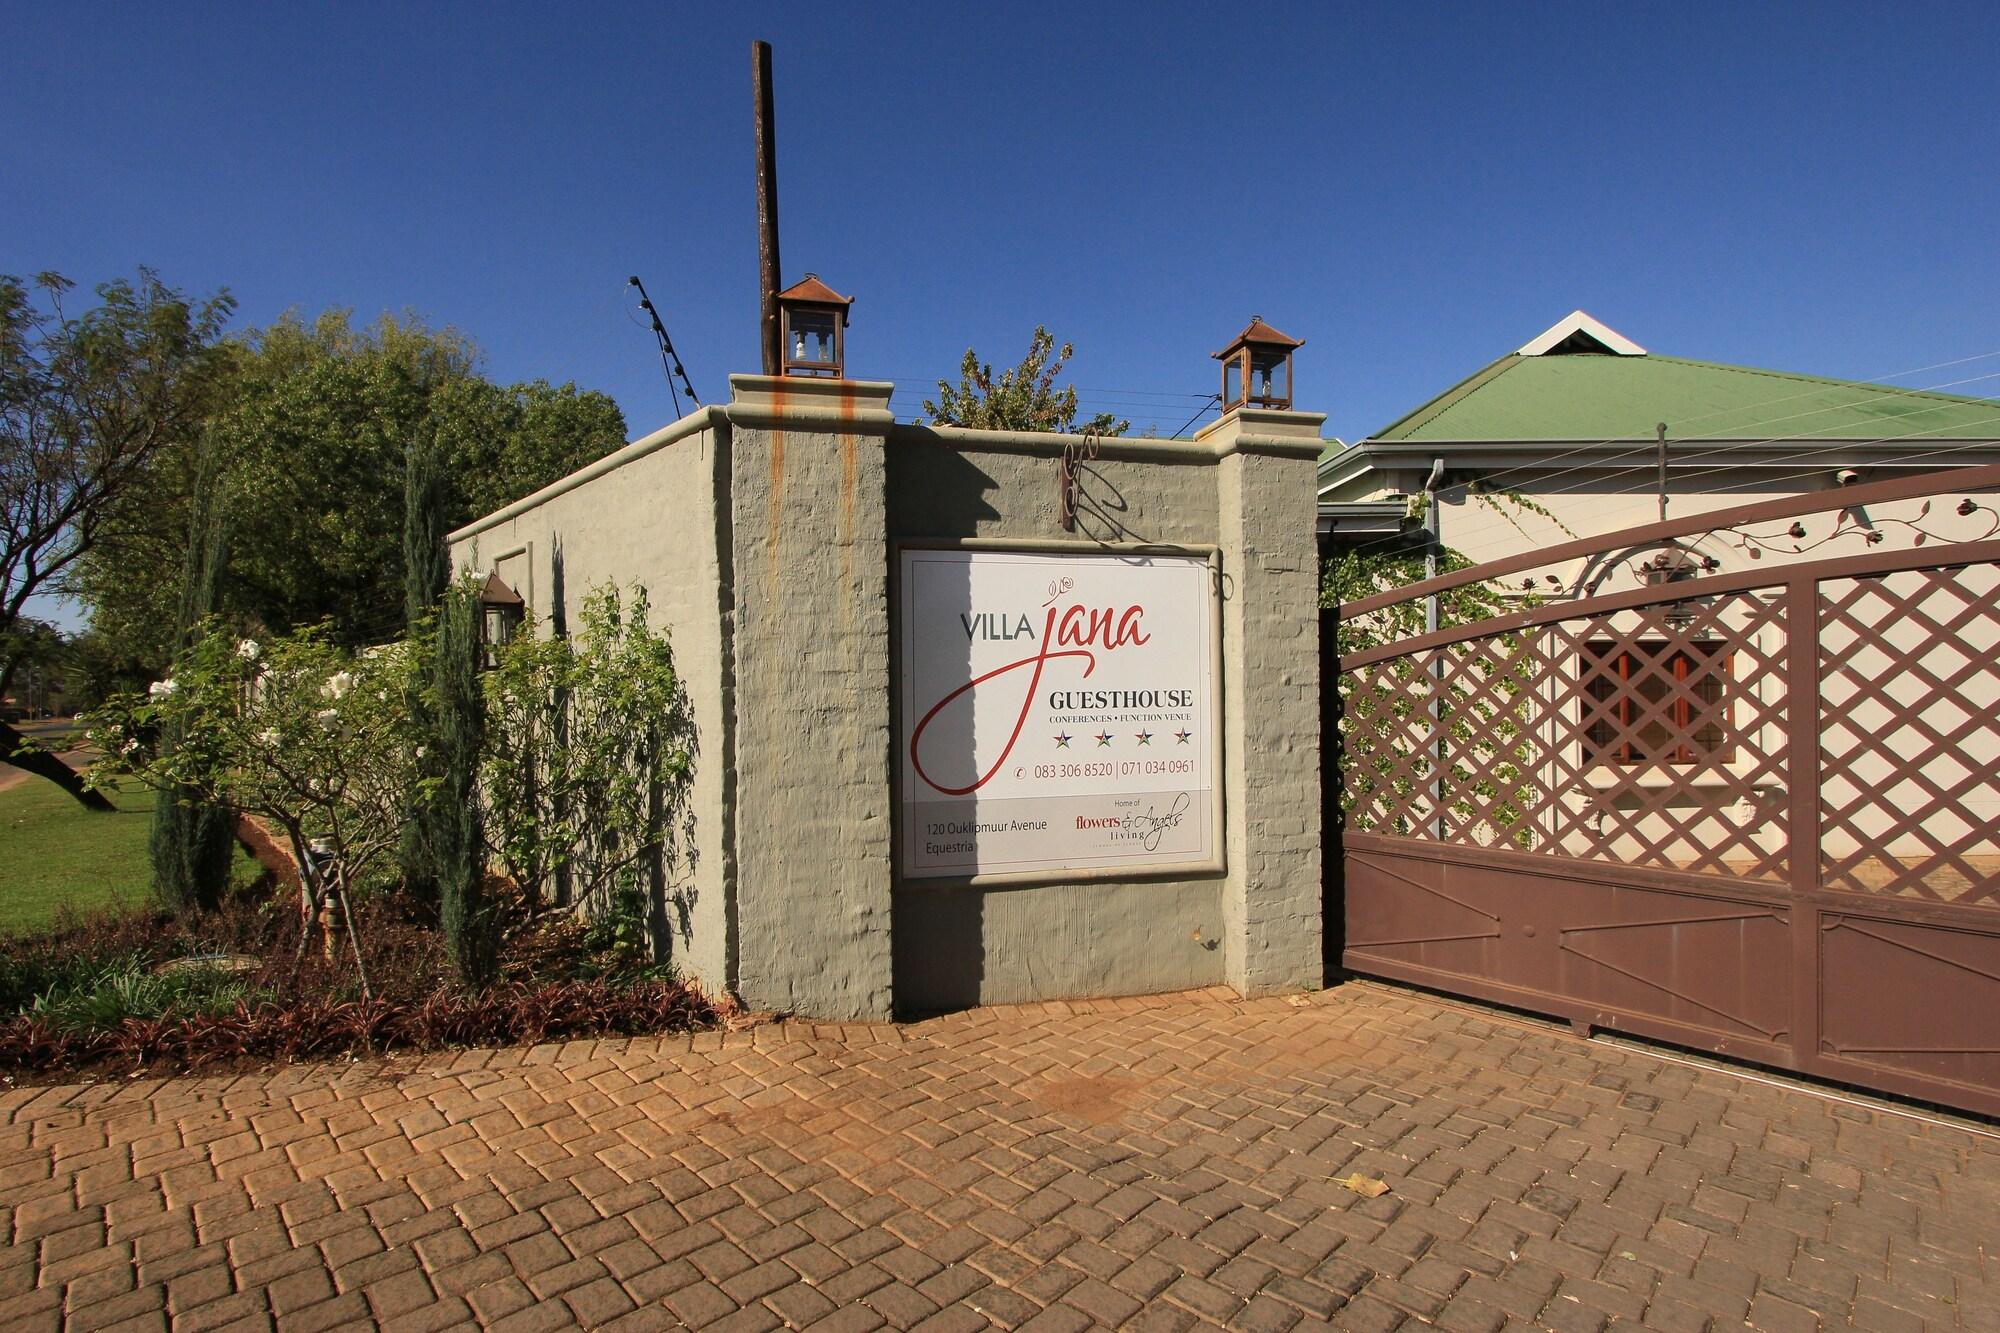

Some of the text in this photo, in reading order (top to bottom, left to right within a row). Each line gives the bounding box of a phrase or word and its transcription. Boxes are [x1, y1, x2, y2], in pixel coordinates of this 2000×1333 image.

[959, 613, 1036, 641] VILLA
[1049, 690, 1193, 710] GUESTHOUSE
[1049, 713, 1192, 724] CONFERENCES FUNCTION VENUE
[1034, 760, 1195, 779] 083 306 8520 071 034 0961
[1114, 799, 1140, 808] Home of
[927, 820, 1047, 836] 120 Ouklipmuur Avenue
[1076, 815, 1121, 830] flowers
[1134, 792, 1191, 851] Angels
[1110, 830, 1145, 841] living
[926, 841, 974, 856] Equestria
